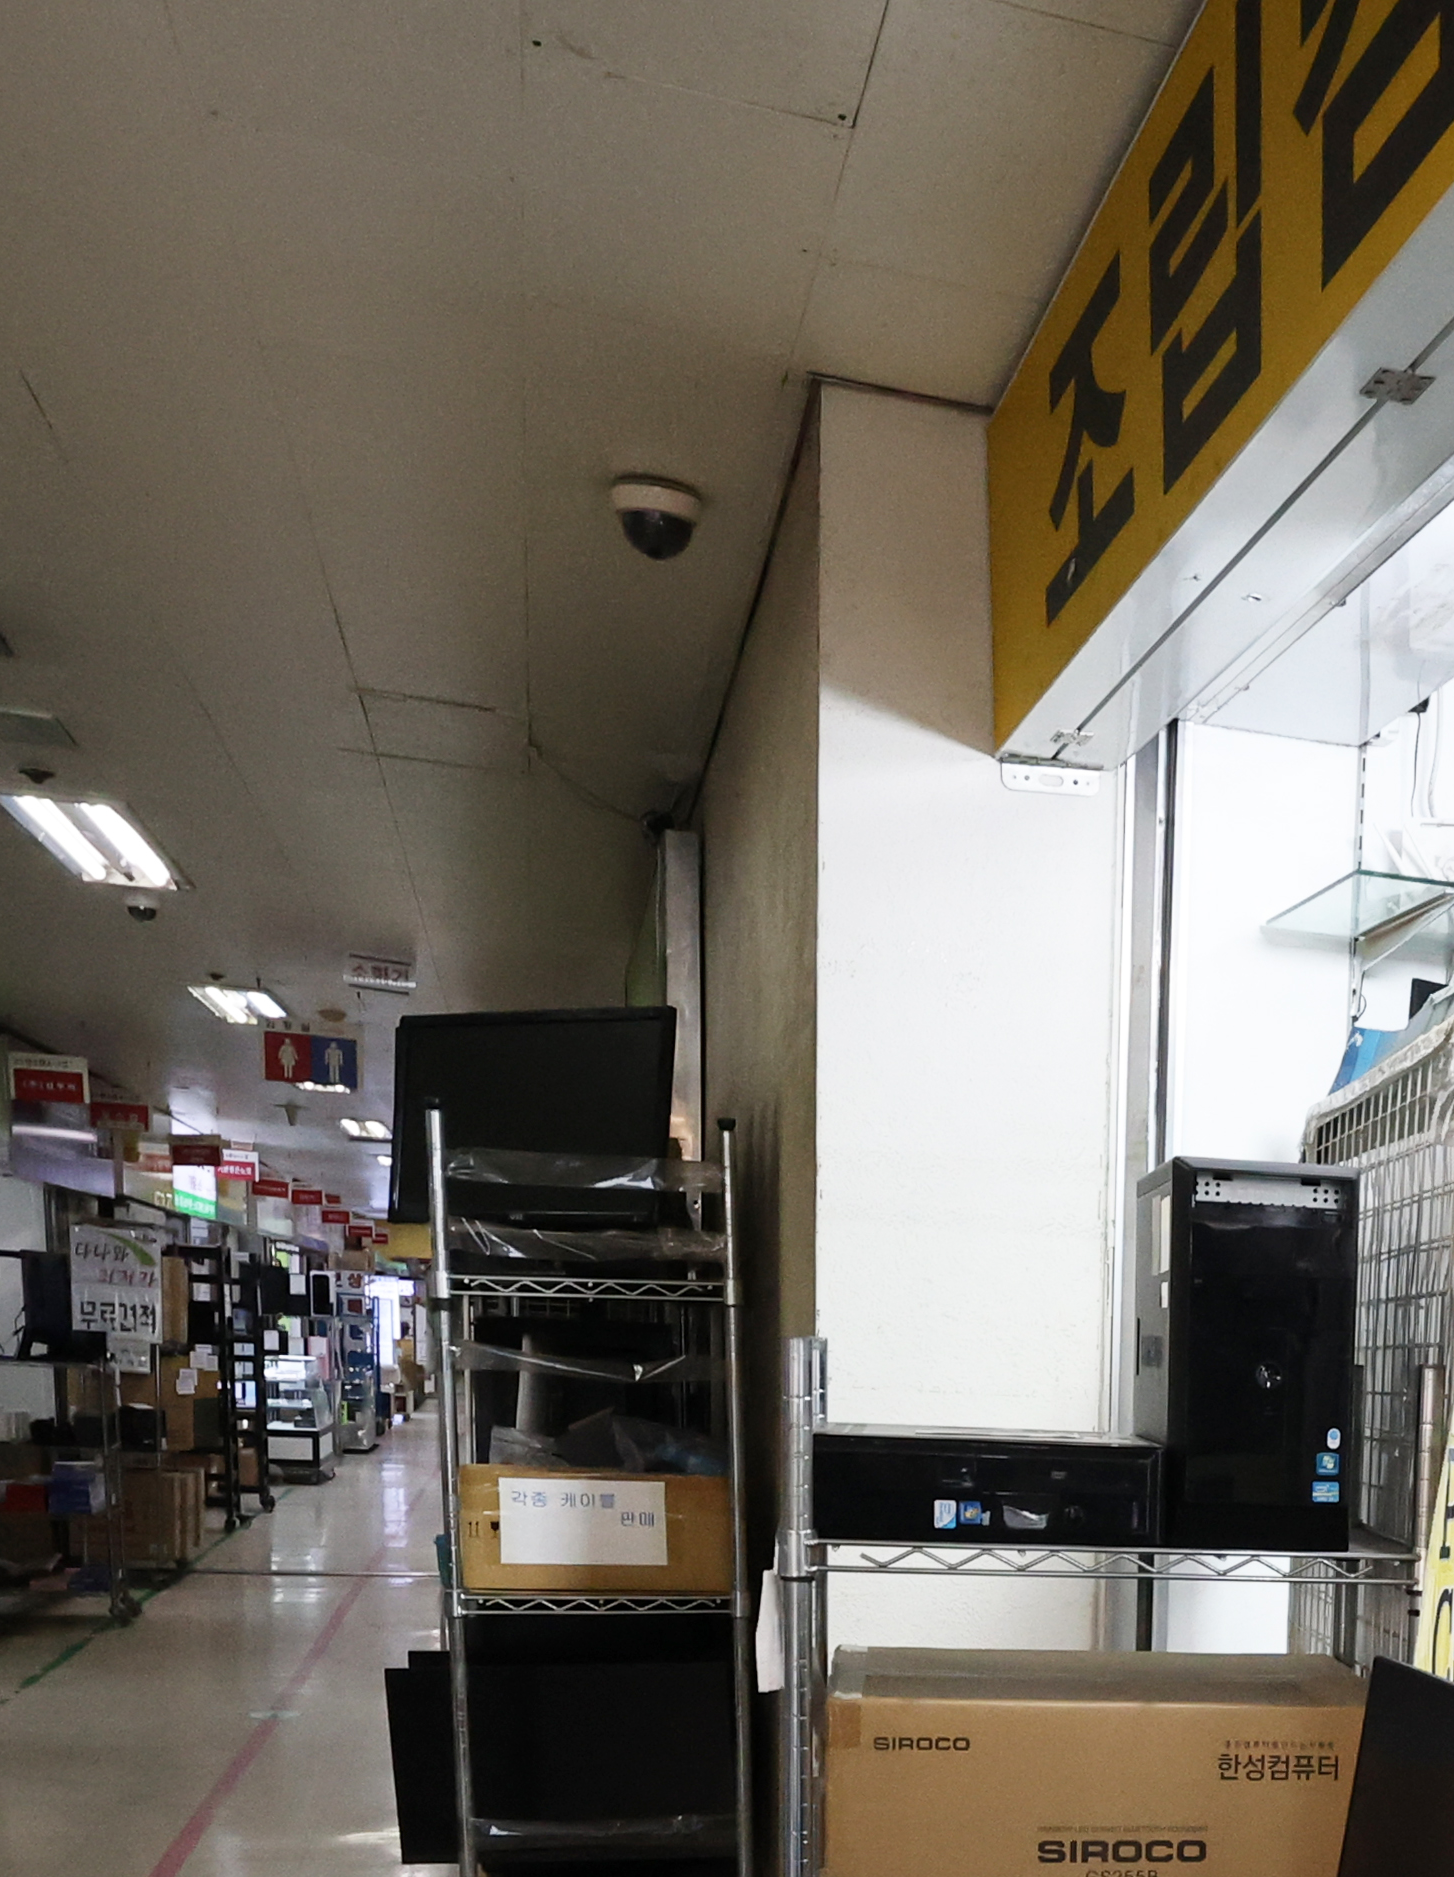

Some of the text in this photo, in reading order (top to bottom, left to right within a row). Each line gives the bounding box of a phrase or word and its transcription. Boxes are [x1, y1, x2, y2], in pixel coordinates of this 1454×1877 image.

[873, 1735, 971, 1752] SIROCO
[1218, 1753, 1339, 1782] 한성컴퓨터
[1037, 1839, 1207, 1864] SIROCO
